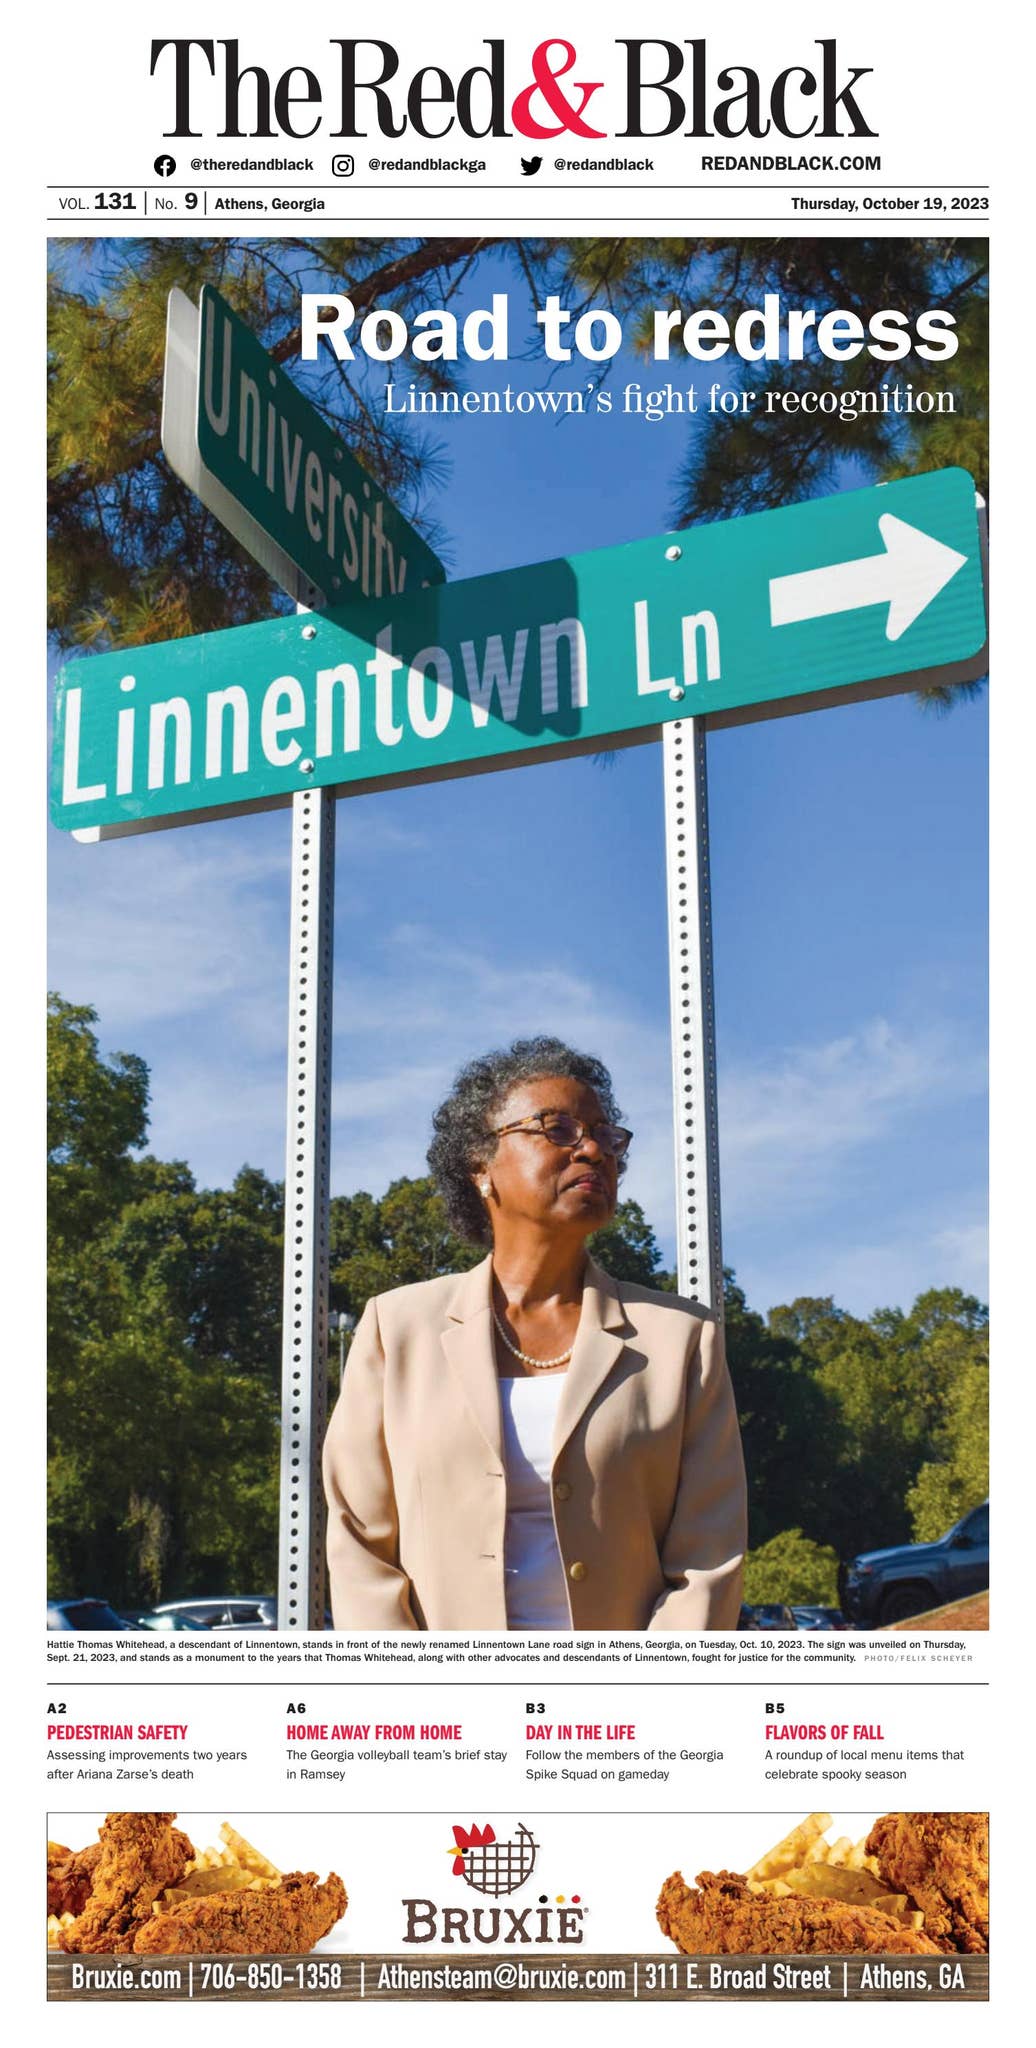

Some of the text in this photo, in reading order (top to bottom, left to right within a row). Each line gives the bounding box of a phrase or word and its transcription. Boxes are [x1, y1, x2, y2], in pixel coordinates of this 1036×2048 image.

[150, 39, 322, 139] The
[615, 39, 879, 138] Black
[190, 157, 314, 171] @theredandblack
[368, 157, 487, 174] @redandblackga
[553, 157, 655, 171] @redandblack
[701, 155, 882, 171] REDANDBLACK.COM
[58, 191, 326, 213] VOL. 131 No. 9 Athens, Georgia
[790, 196, 990, 213] Thursday, October 19, 2023
[302, 295, 958, 360] Road to redress
[622, 383, 698, 422] fight
[708, 383, 756, 413] for
[765, 383, 956, 422] recognition
[62, 600, 721, 805] Linnentown Ln
[46, 1639, 967, 1651] Hattie Thomas Whitehead, a descendant of Linnentown, stands in front of the newly renamed Linnentown Lane road sign in Athens, Georgia, on Tuesday, Oct. 10, 2023. The sign was unveiled on Thursday,
[46, 1652, 857, 1664] Sept. 21, 2023, and stands as a monument to the years that Thomas Whitehead, along with other advocates and descendants of Linnentown, fought for justice for the community.
[863, 1654, 974, 1663] PHOTO/FELIX SCHEYER
[46, 1702, 67, 1715] A2
[285, 1702, 307, 1715] A6
[525, 1702, 546, 1714] B3
[765, 1702, 786, 1714] B5
[47, 1724, 188, 1741] PEDESTRIAN SAFETY
[286, 1724, 463, 1740] HOME AWAY FROM HOME
[526, 1724, 636, 1740] DAY IN THE LIFE
[765, 1724, 885, 1741] FLAVORS OF FALL
[46, 1749, 248, 1763] Assessing improvements two years
[285, 1749, 308, 1761] The
[310, 1749, 355, 1763] Georgia
[357, 1749, 410, 1763] volleyball
[454, 1749, 481, 1761] brief
[483, 1749, 508, 1763] stay
[525, 1749, 724, 1763] Follow the members of the Georgia
[764, 1749, 965, 1763] A roundup of local menu items that
[46, 1768, 75, 1780] after
[76, 1768, 113, 1780] Ariana
[160, 1768, 194, 1780] death
[286, 1768, 346, 1782] in Ramsey
[525, 1768, 670, 1782] Spike Squad on gameday
[764, 1768, 907, 1782] celebrate spooky season
[72, 1963, 965, 1991] Bruxie.com 706-850-1358 Athensteam@bruxie.com 311 E. Broad Street Athens, GA
